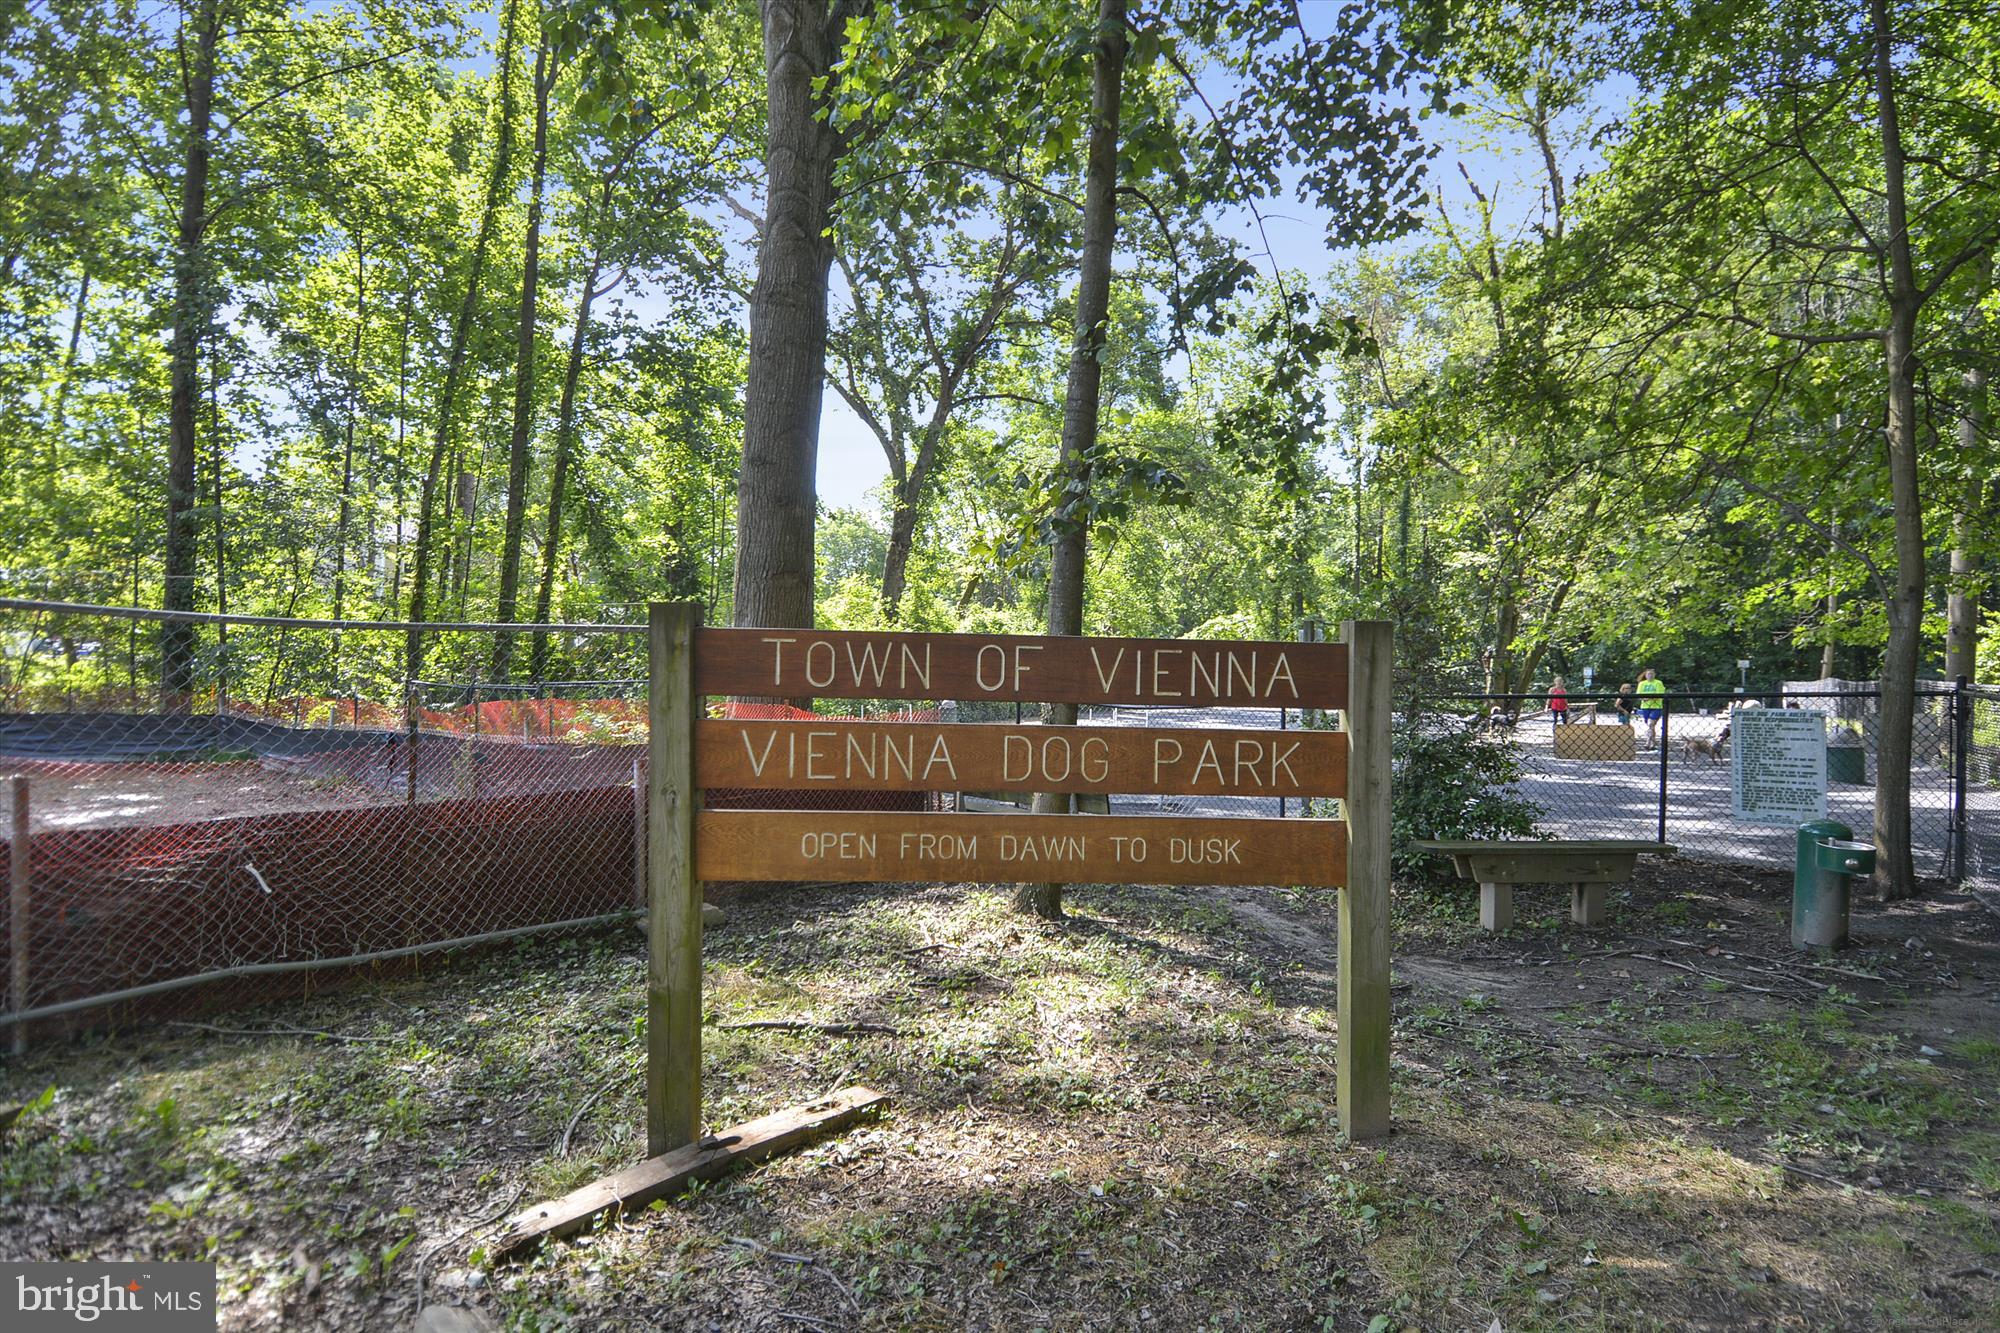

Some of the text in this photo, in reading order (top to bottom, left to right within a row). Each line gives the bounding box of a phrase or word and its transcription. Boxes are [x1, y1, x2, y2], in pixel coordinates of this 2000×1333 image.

[763, 637, 1300, 699] TOWN OF VIENNA
[741, 730, 1301, 788] VIENNA DOG PARK
[800, 832, 1242, 864] OPEN FROM DAWN TO DUSK
